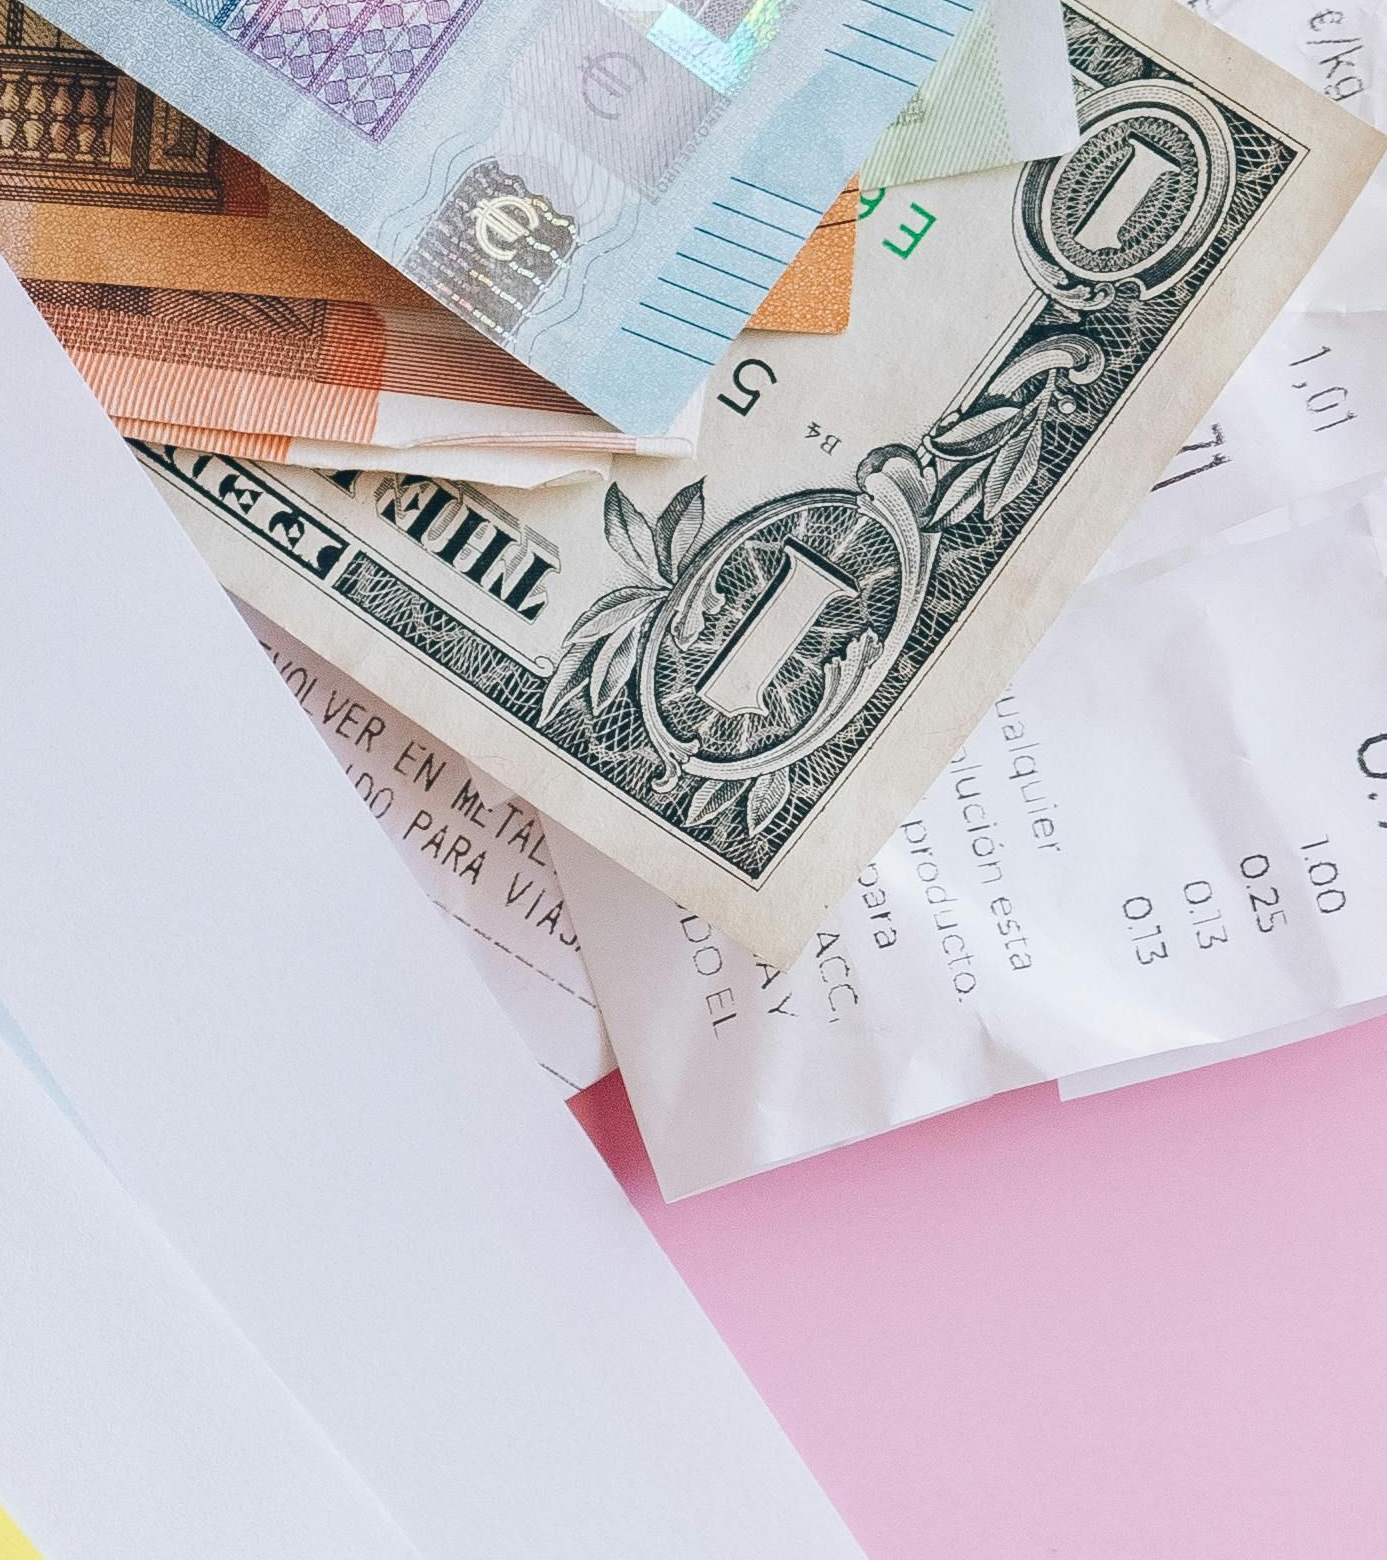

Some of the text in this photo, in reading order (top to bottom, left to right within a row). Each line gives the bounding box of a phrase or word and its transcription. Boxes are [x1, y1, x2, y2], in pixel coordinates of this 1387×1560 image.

[1308, 9, 1365, 103] €/kg
[1288, 344, 1358, 433] 1,01
[373, 470, 562, 624] THE
[392, 739, 448, 793] EN
[401, 808, 488, 886] PARA
[1300, 838, 1348, 915] 1.00
[898, 818, 978, 1004] producto.
[1121, 895, 1170, 966] 0.13
[1182, 879, 1229, 951] 0.13
[1238, 853, 1285, 934] 0.25
[989, 895, 1033, 972] esta
[704, 986, 738, 1038] EL
